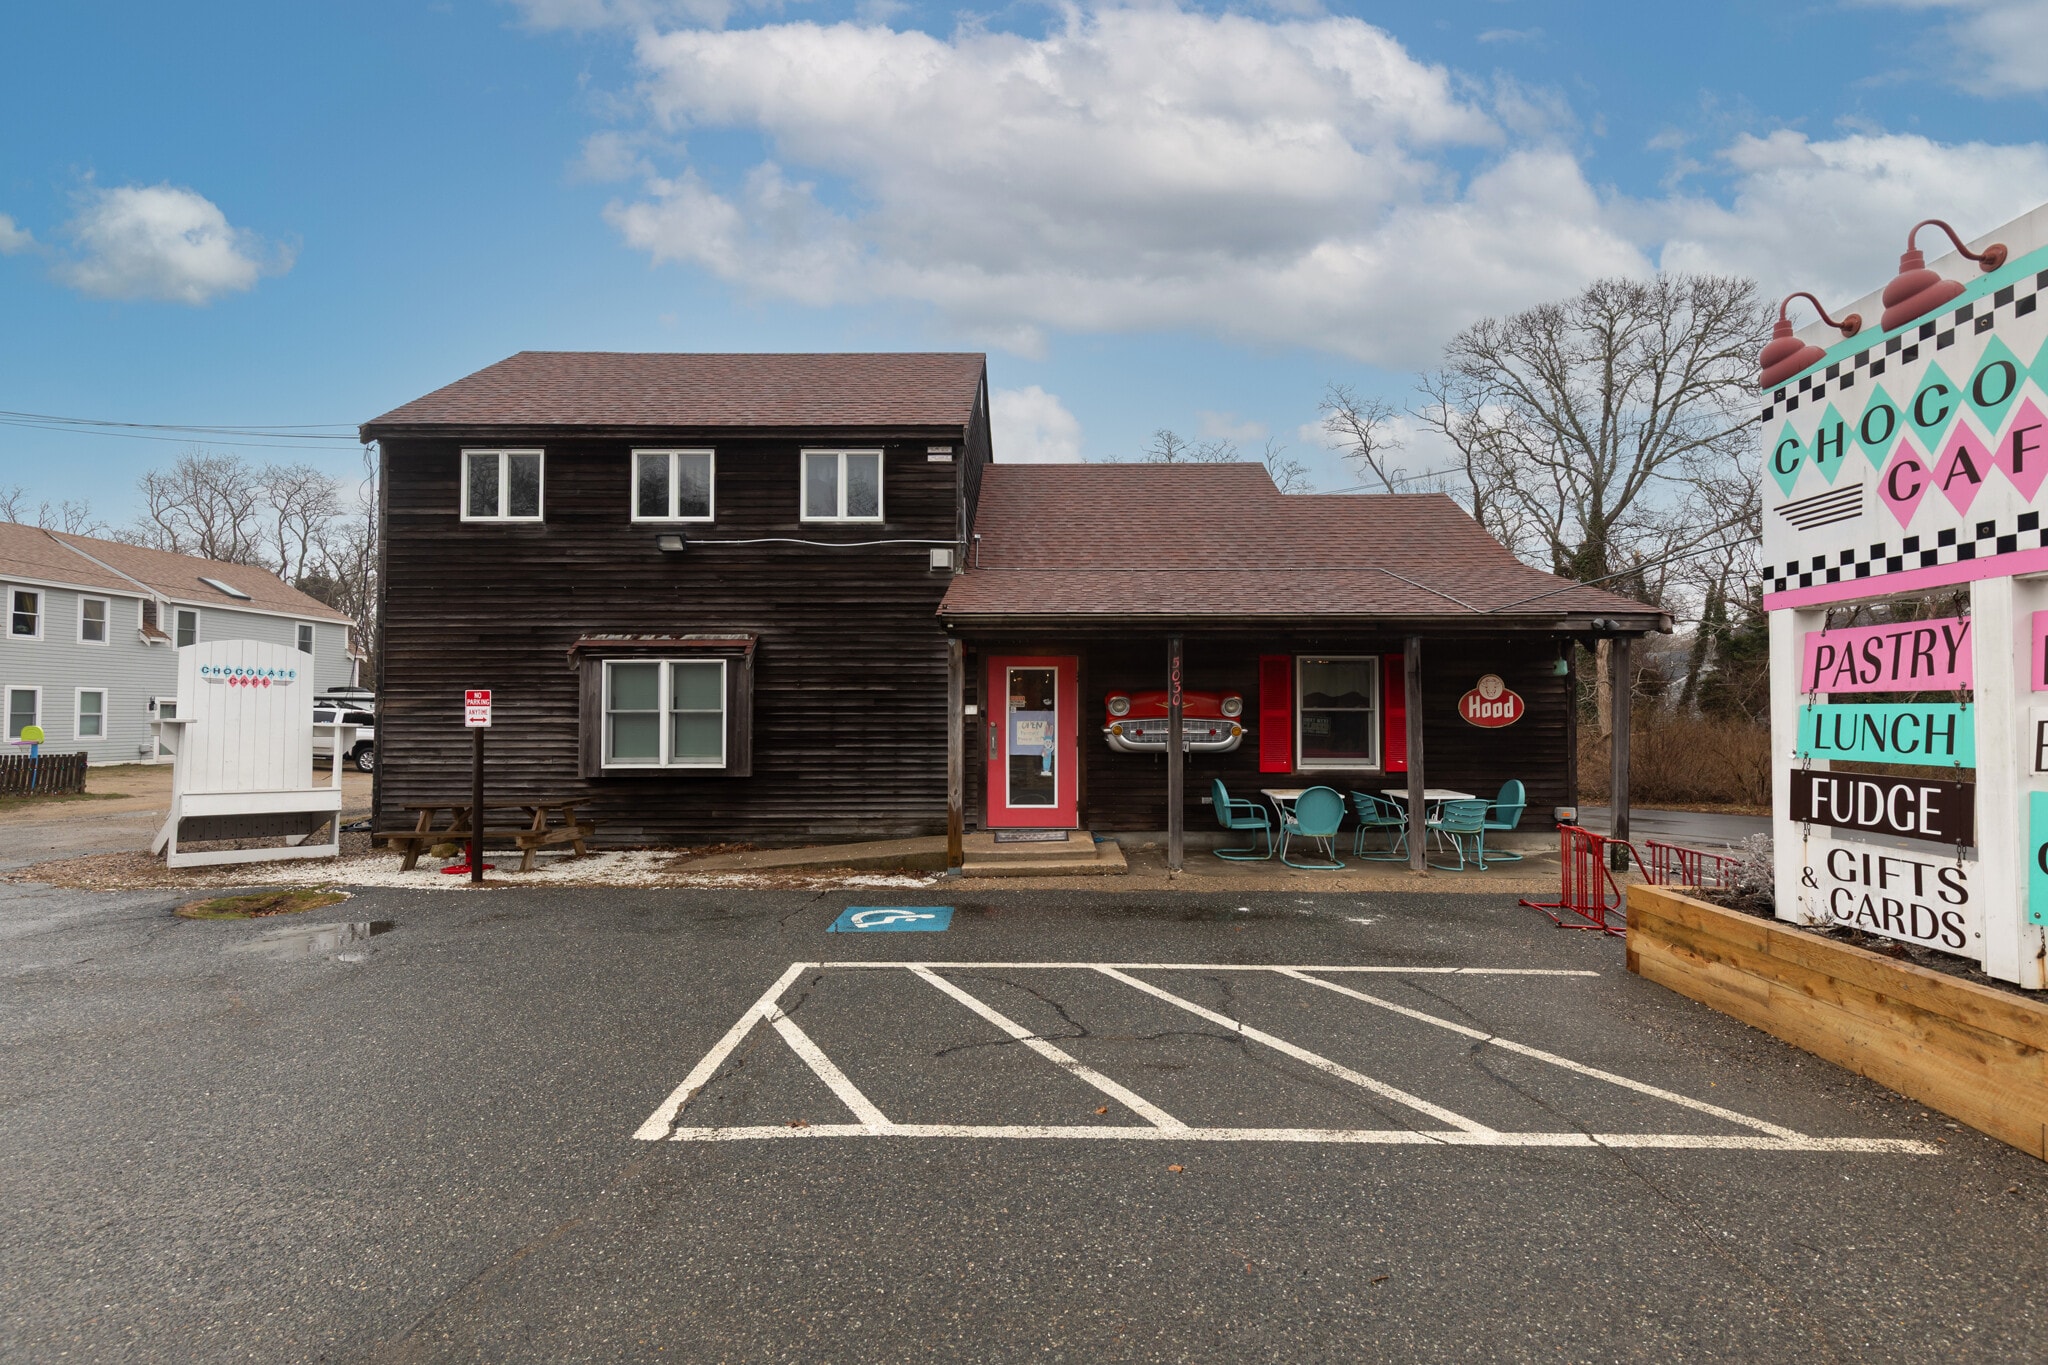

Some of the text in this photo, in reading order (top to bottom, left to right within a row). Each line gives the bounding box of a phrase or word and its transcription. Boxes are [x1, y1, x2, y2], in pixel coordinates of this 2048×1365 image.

[1775, 360, 2017, 475] CHOCO
[1887, 423, 2043, 501] CAF
[201, 666, 295, 678] CHOCOLATE
[1172, 657, 1181, 706] 5030
[1813, 621, 1970, 689] PASTRY
[1468, 695, 1514, 718] Hood
[1814, 713, 1956, 755] LUNCH
[1811, 777, 1942, 836] FUDGE
[1801, 848, 1970, 905] & GIFTS
[1830, 887, 1967, 949] CARDS
